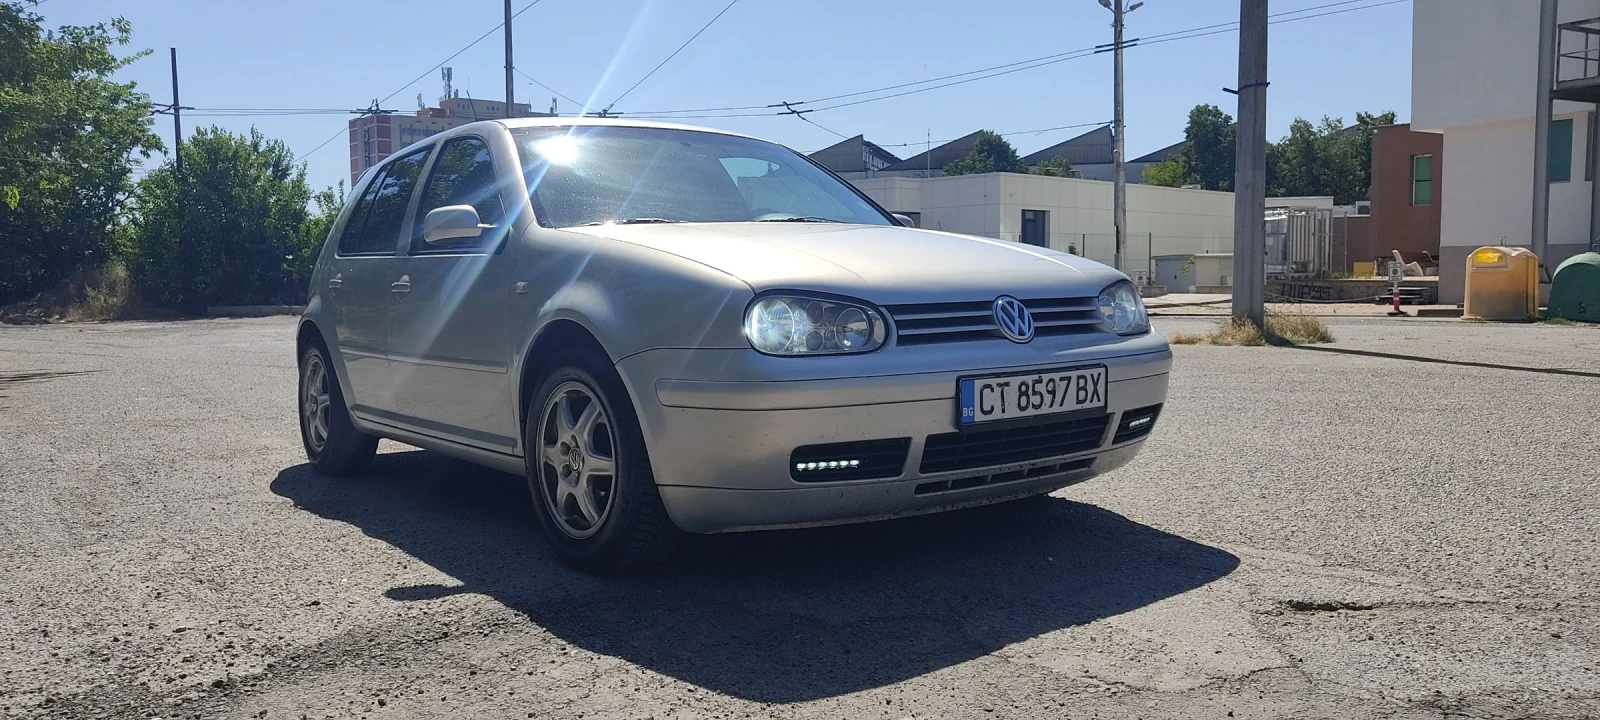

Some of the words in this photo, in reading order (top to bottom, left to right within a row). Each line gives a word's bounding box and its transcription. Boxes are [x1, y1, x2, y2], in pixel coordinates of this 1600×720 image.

[979, 381, 1011, 416] CT
[1017, 376, 1073, 412] 8597
[1075, 372, 1102, 405] BX
[962, 407, 974, 418] BG
